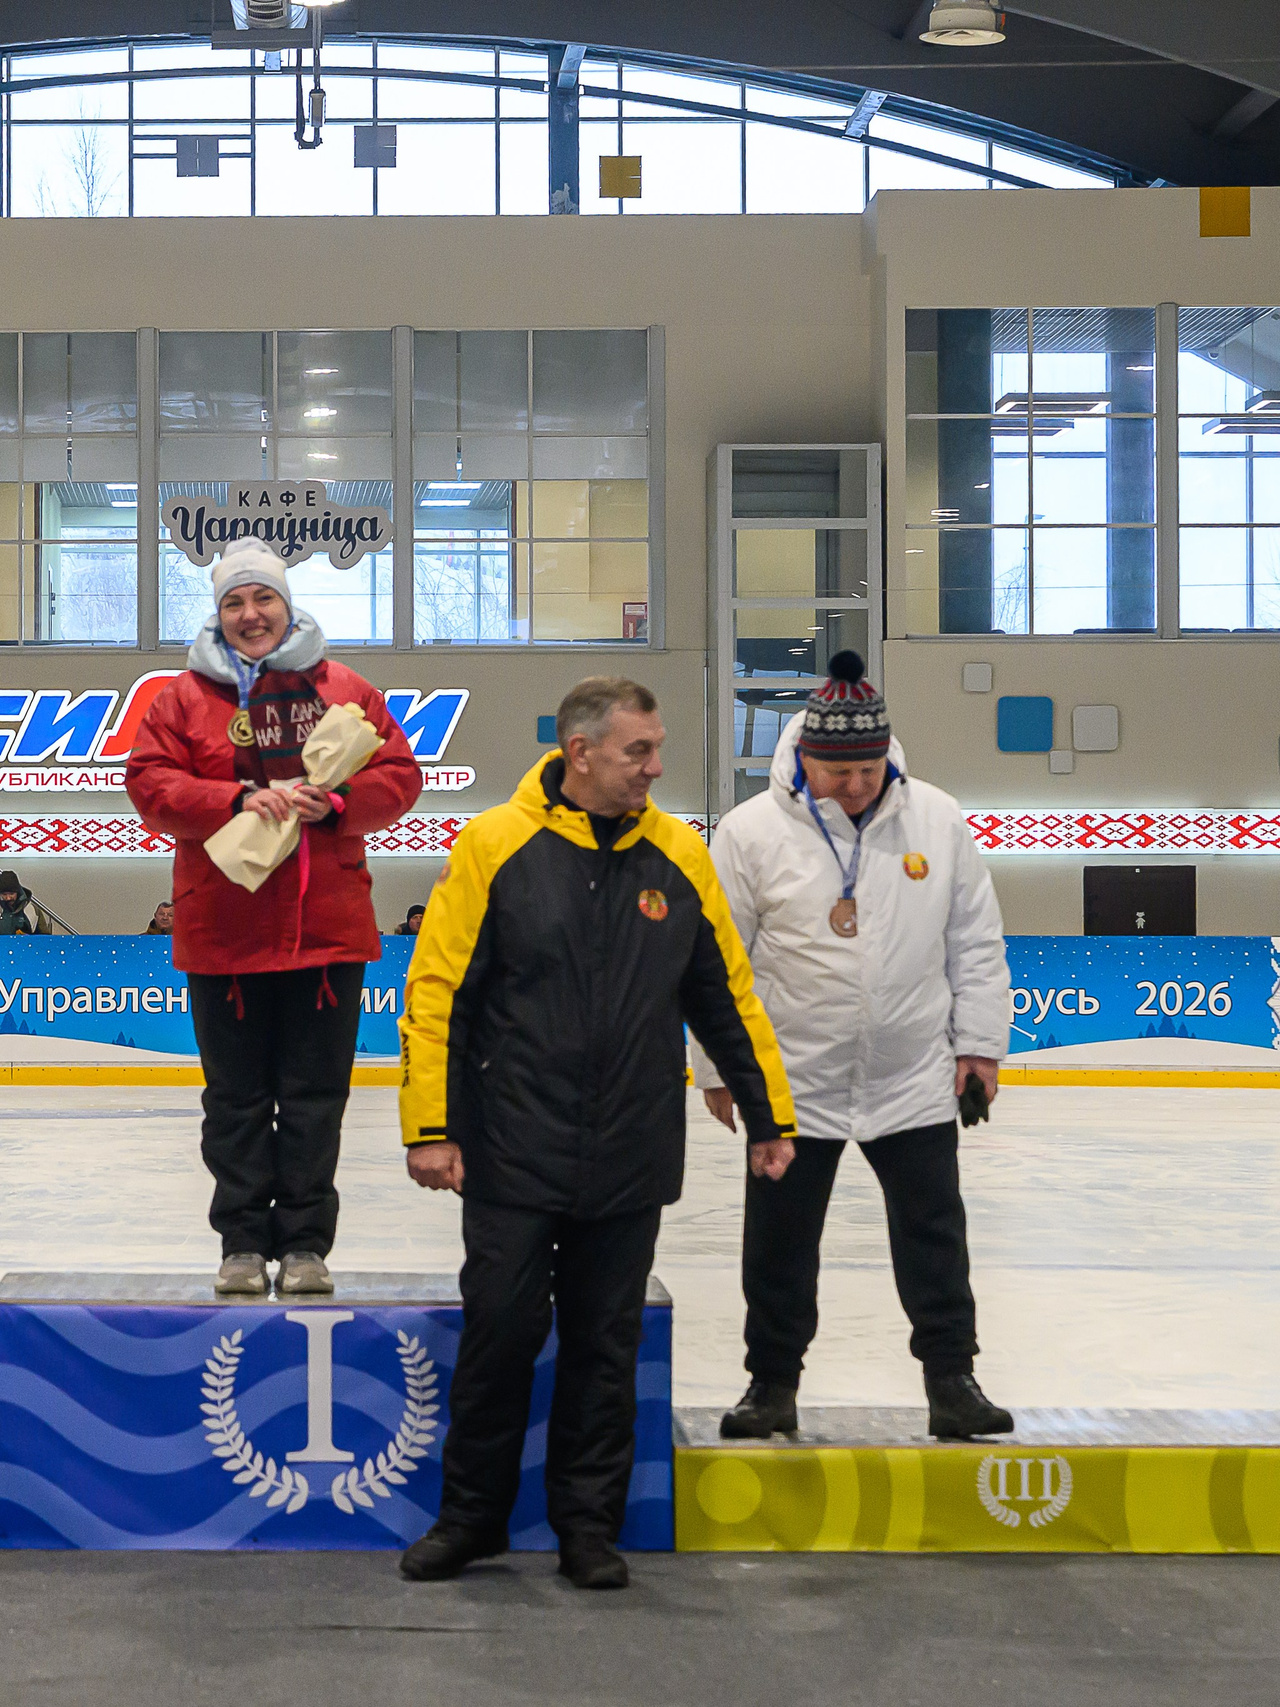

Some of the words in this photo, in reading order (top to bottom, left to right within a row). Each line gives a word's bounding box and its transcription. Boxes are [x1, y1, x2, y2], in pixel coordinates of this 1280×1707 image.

[238, 490, 316, 507] КАФЕ
[172, 506, 384, 559] Чараўніца
[1008, 987, 1101, 1024] русь
[1134, 980, 1233, 1017] 2026
[993, 1457, 1057, 1502] III
